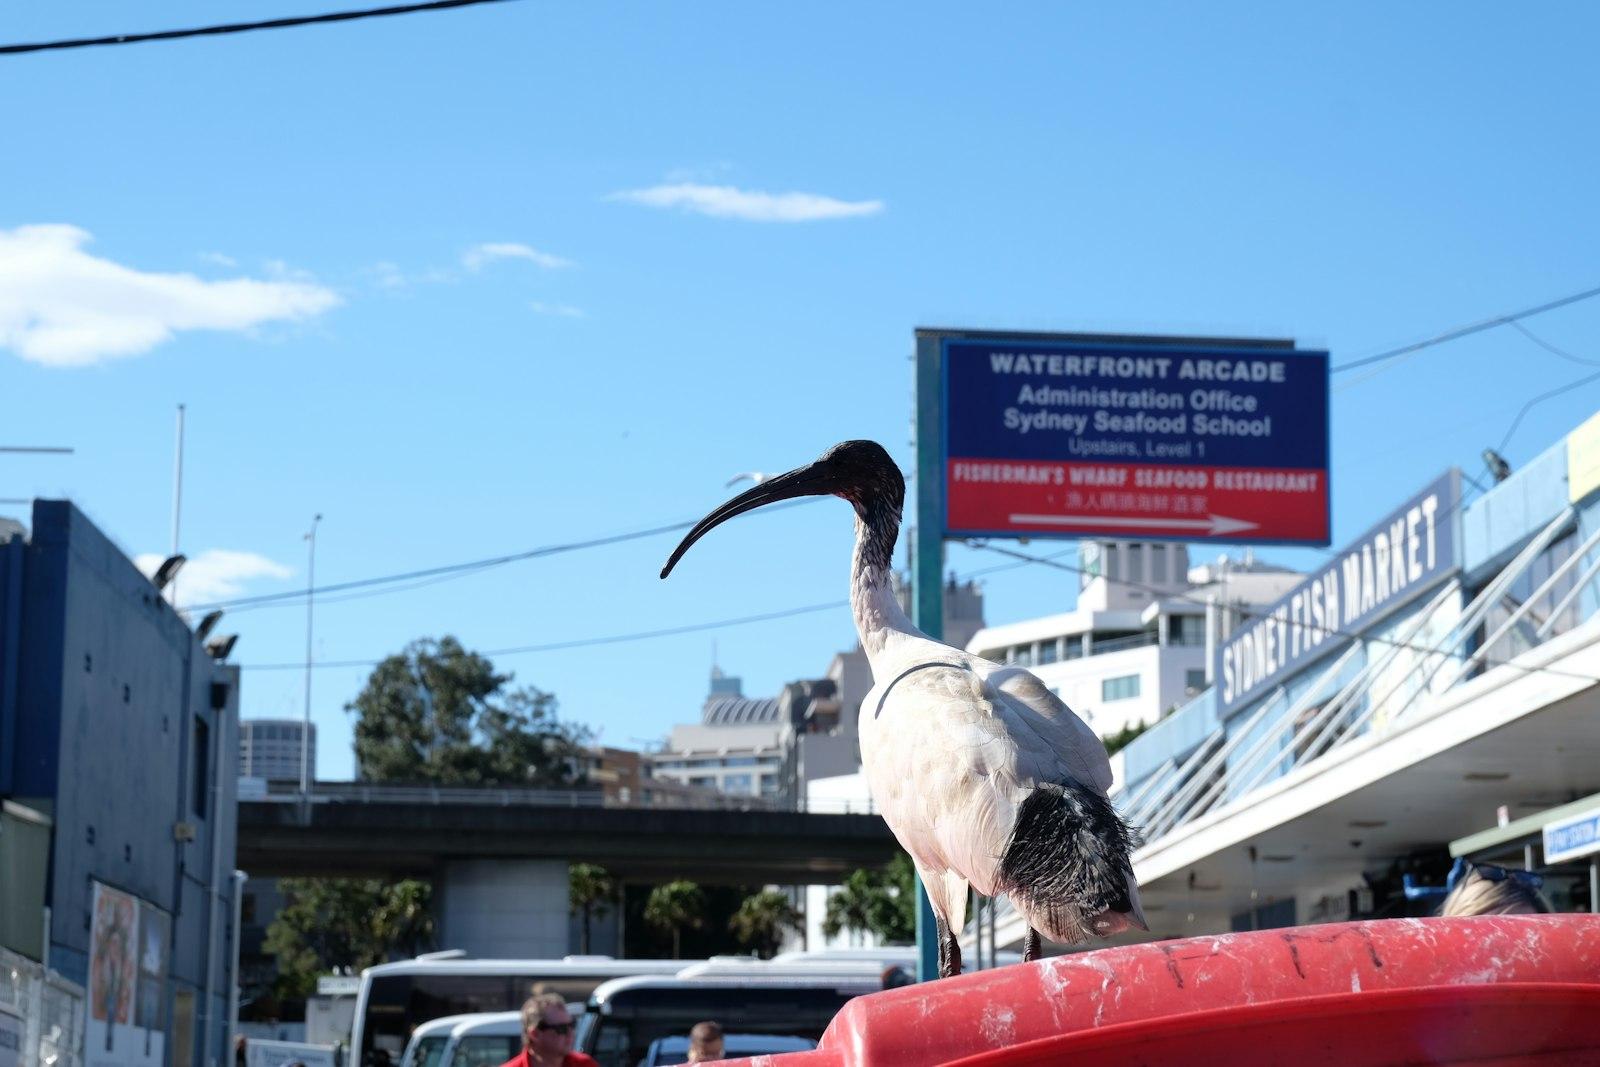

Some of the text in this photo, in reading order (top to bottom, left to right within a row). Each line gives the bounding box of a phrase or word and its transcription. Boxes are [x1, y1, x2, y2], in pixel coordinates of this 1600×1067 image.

[990, 353, 1286, 383] WATERFRONT ARCADE
[1018, 384, 1257, 412] Administration Office
[1004, 407, 1271, 437] Sydney Seafood School
[1146, 441, 1192, 458] Level
[1198, 443, 1205, 458] 1
[953, 462, 1317, 492] FISHERMAN'S WHARF SEAFOOD RESTAURANT
[1223, 493, 1437, 706] SYDNEY FISH MARKET
